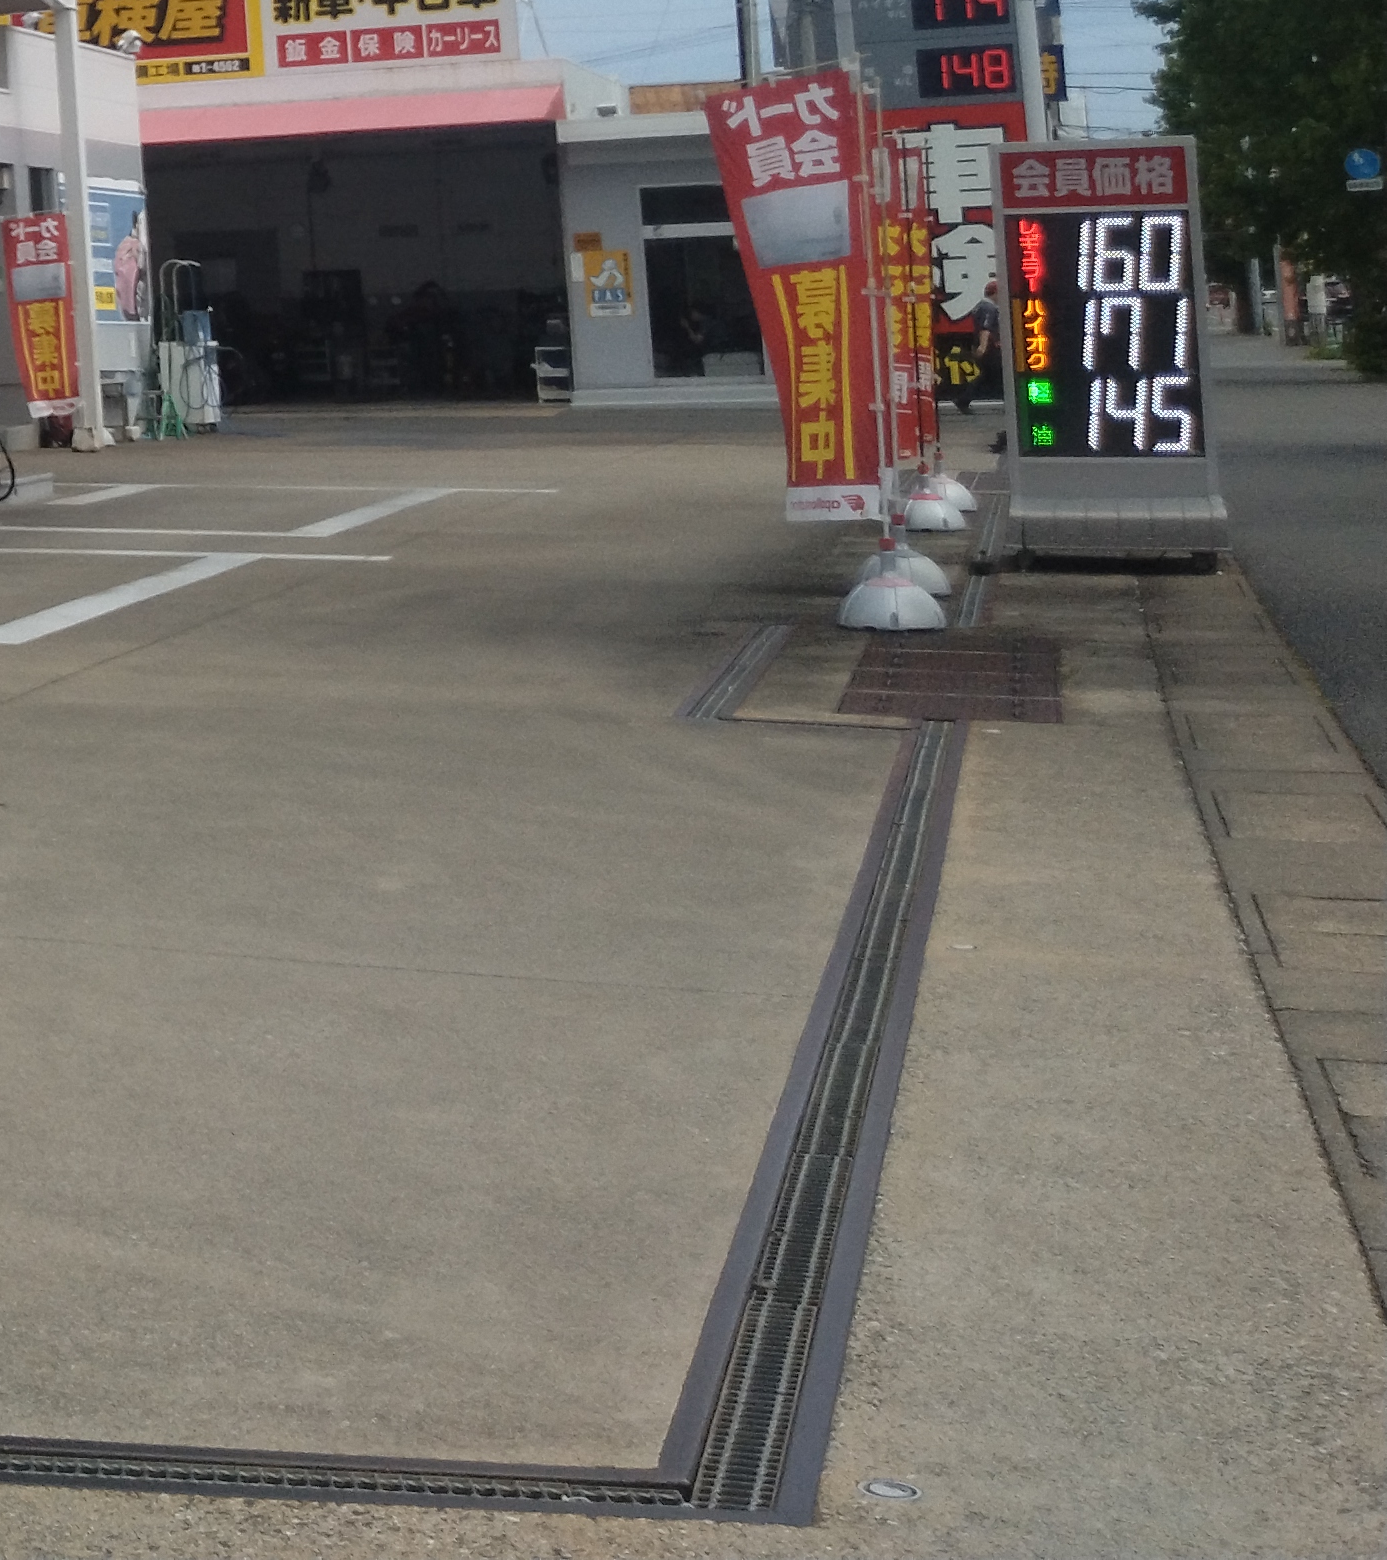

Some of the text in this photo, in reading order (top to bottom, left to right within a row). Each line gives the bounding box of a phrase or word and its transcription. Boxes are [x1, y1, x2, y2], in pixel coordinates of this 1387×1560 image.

[358, 31, 415, 56] 保険
[429, 25, 499, 51] カーリース
[941, 48, 1010, 89] 148
[1012, 155, 1173, 197] 会員価格
[1019, 218, 1043, 291] レギュラー
[1077, 216, 1182, 291] 160
[1024, 298, 1047, 370] ハイオク
[1082, 297, 1188, 371] 171
[1088, 376, 1192, 452] 145
